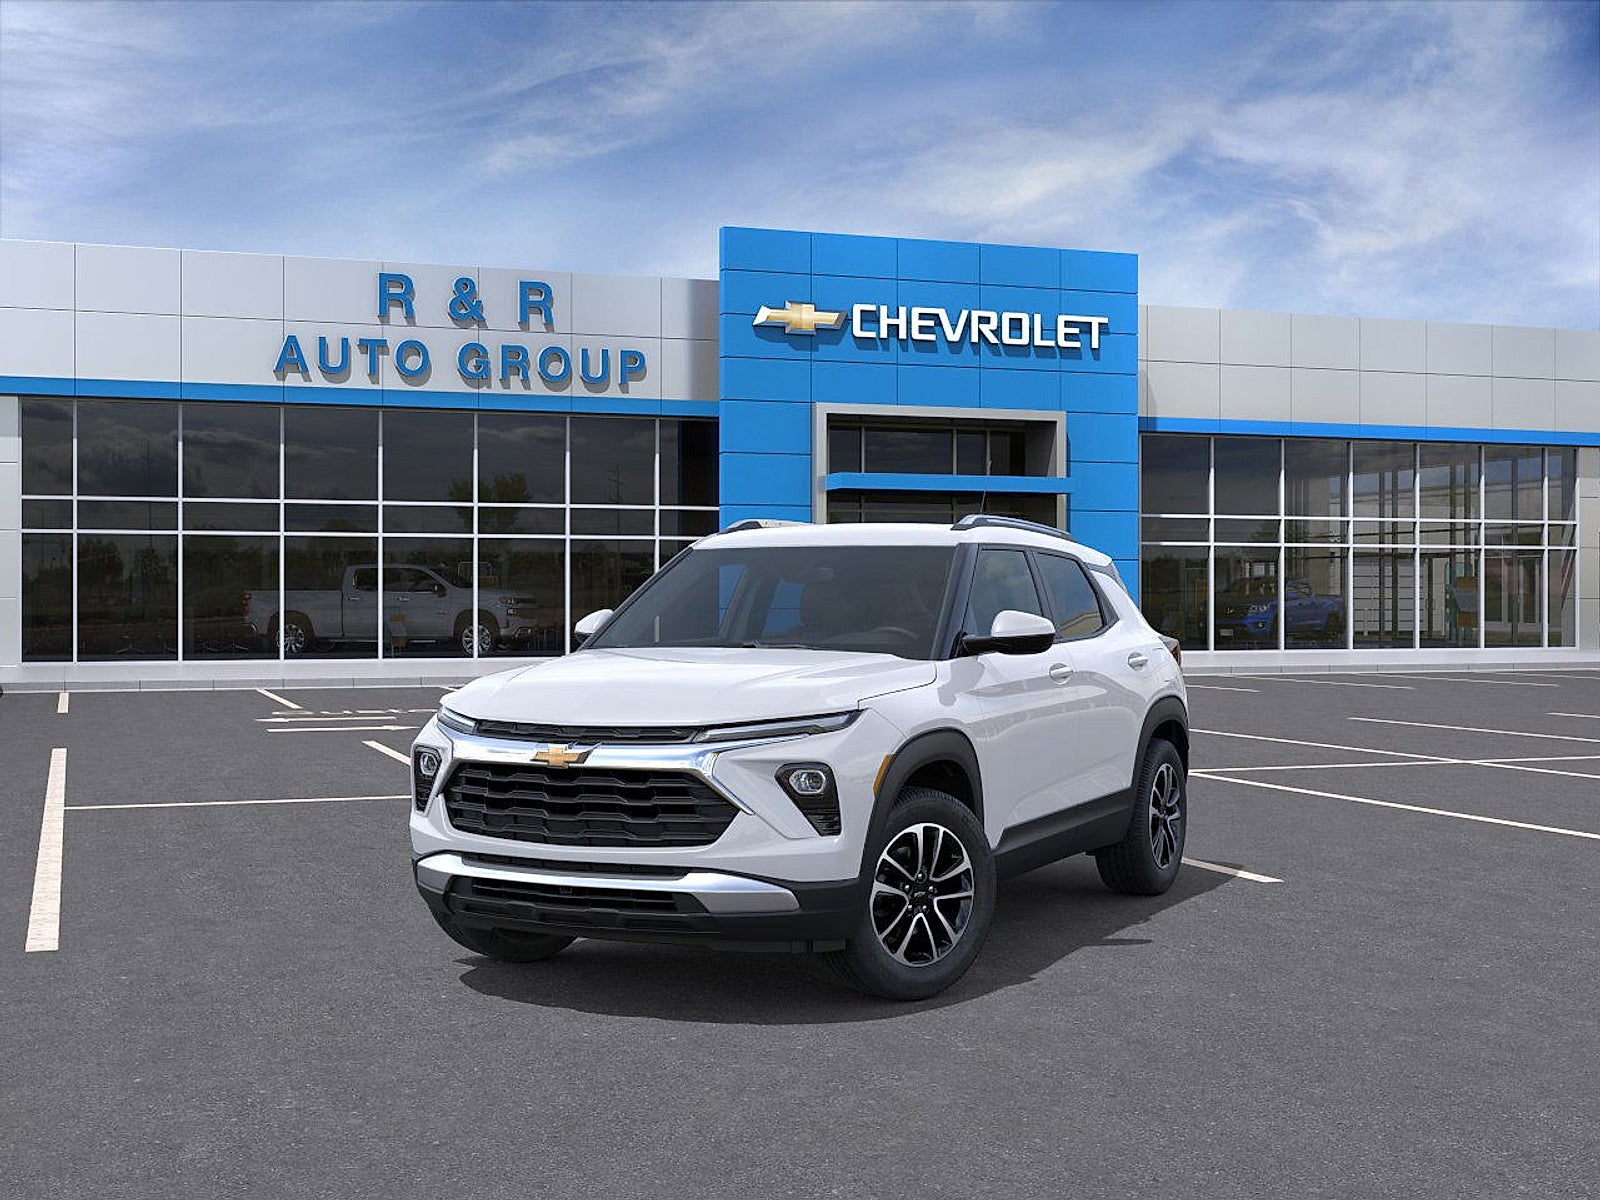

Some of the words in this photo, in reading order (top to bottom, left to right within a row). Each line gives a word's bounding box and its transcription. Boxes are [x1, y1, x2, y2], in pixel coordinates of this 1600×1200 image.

[377, 272, 414, 318] R
[448, 277, 485, 322] &
[517, 280, 553, 324] R
[852, 303, 1109, 349] CHEVROLET
[274, 334, 430, 378] AUTO
[457, 342, 647, 385] GROUP
